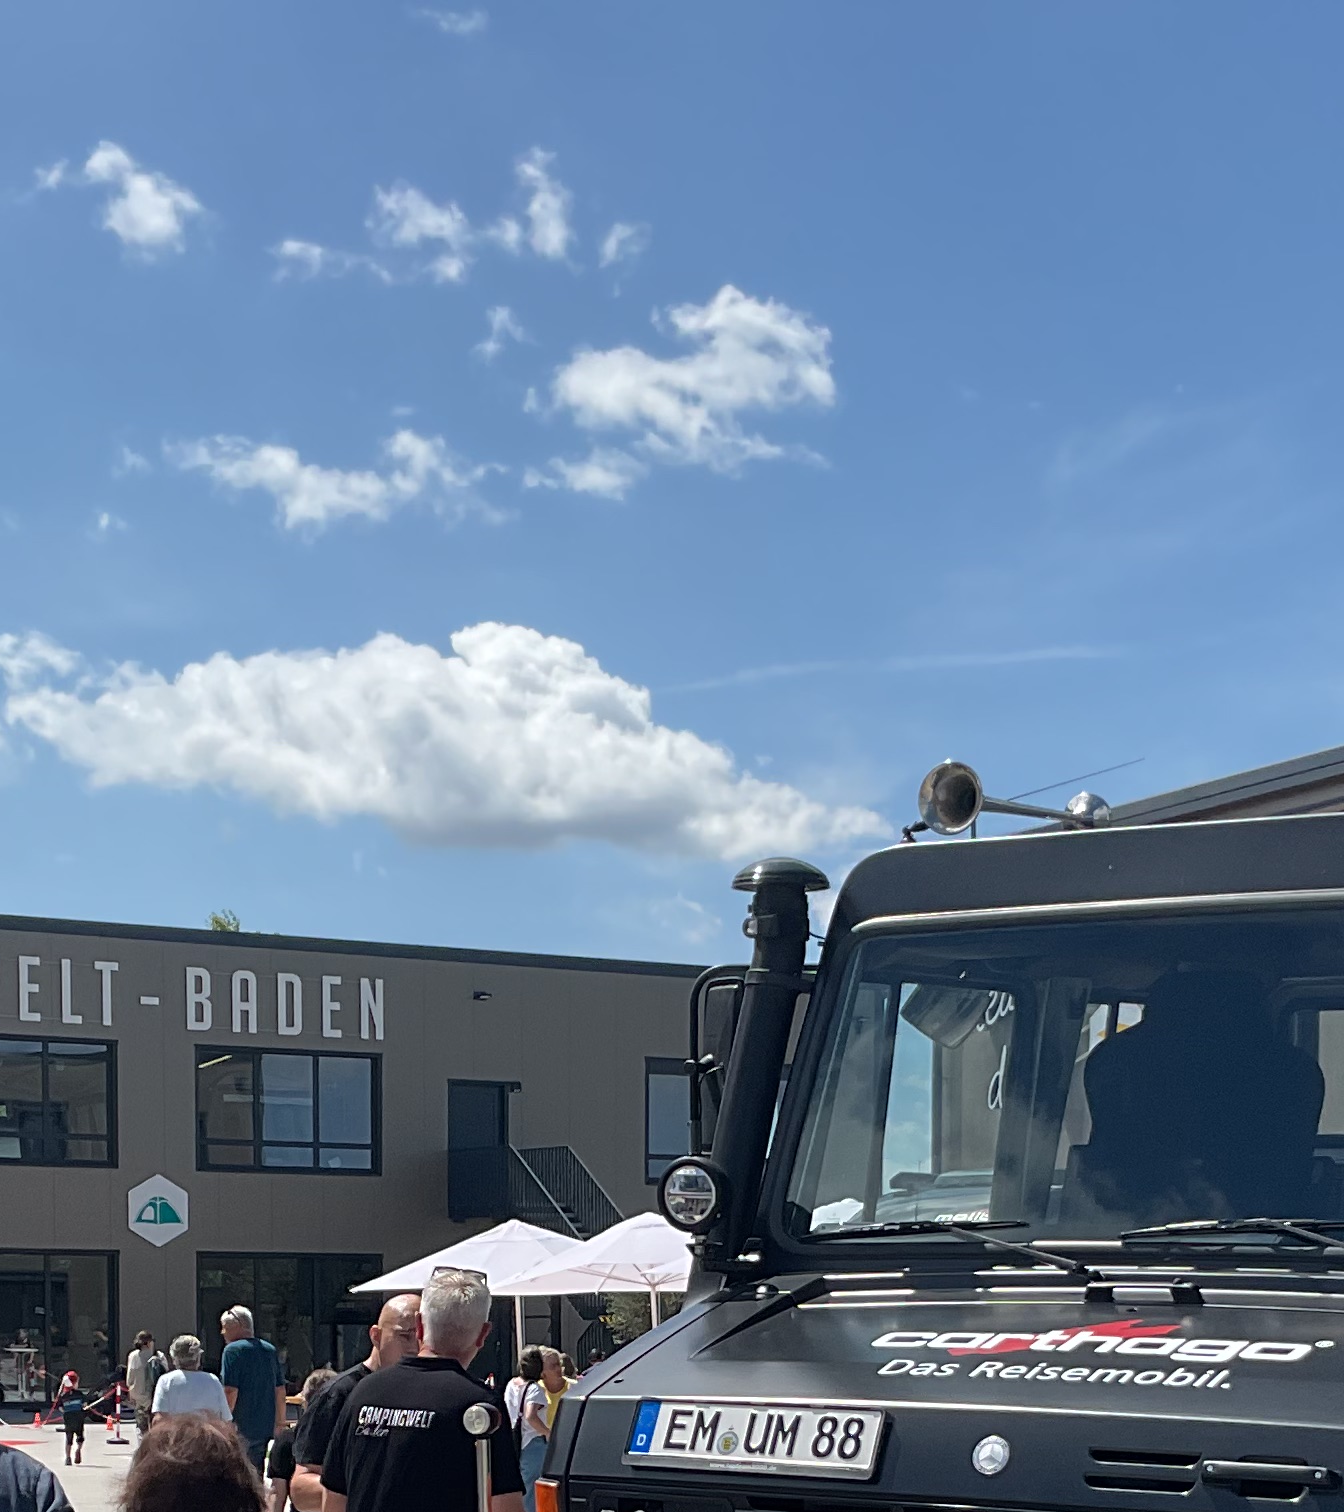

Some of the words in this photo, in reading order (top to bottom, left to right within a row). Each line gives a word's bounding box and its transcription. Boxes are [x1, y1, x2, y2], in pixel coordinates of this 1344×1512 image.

[877, 1358, 960, 1378] Das
[968, 1360, 1232, 1390] Reisemobil.
[358, 1405, 435, 1428] CAMPINGWELT
[636, 1434, 646, 1446] D
[663, 1409, 721, 1451] EM
[743, 1412, 801, 1457] UM
[811, 1416, 864, 1459] 88
